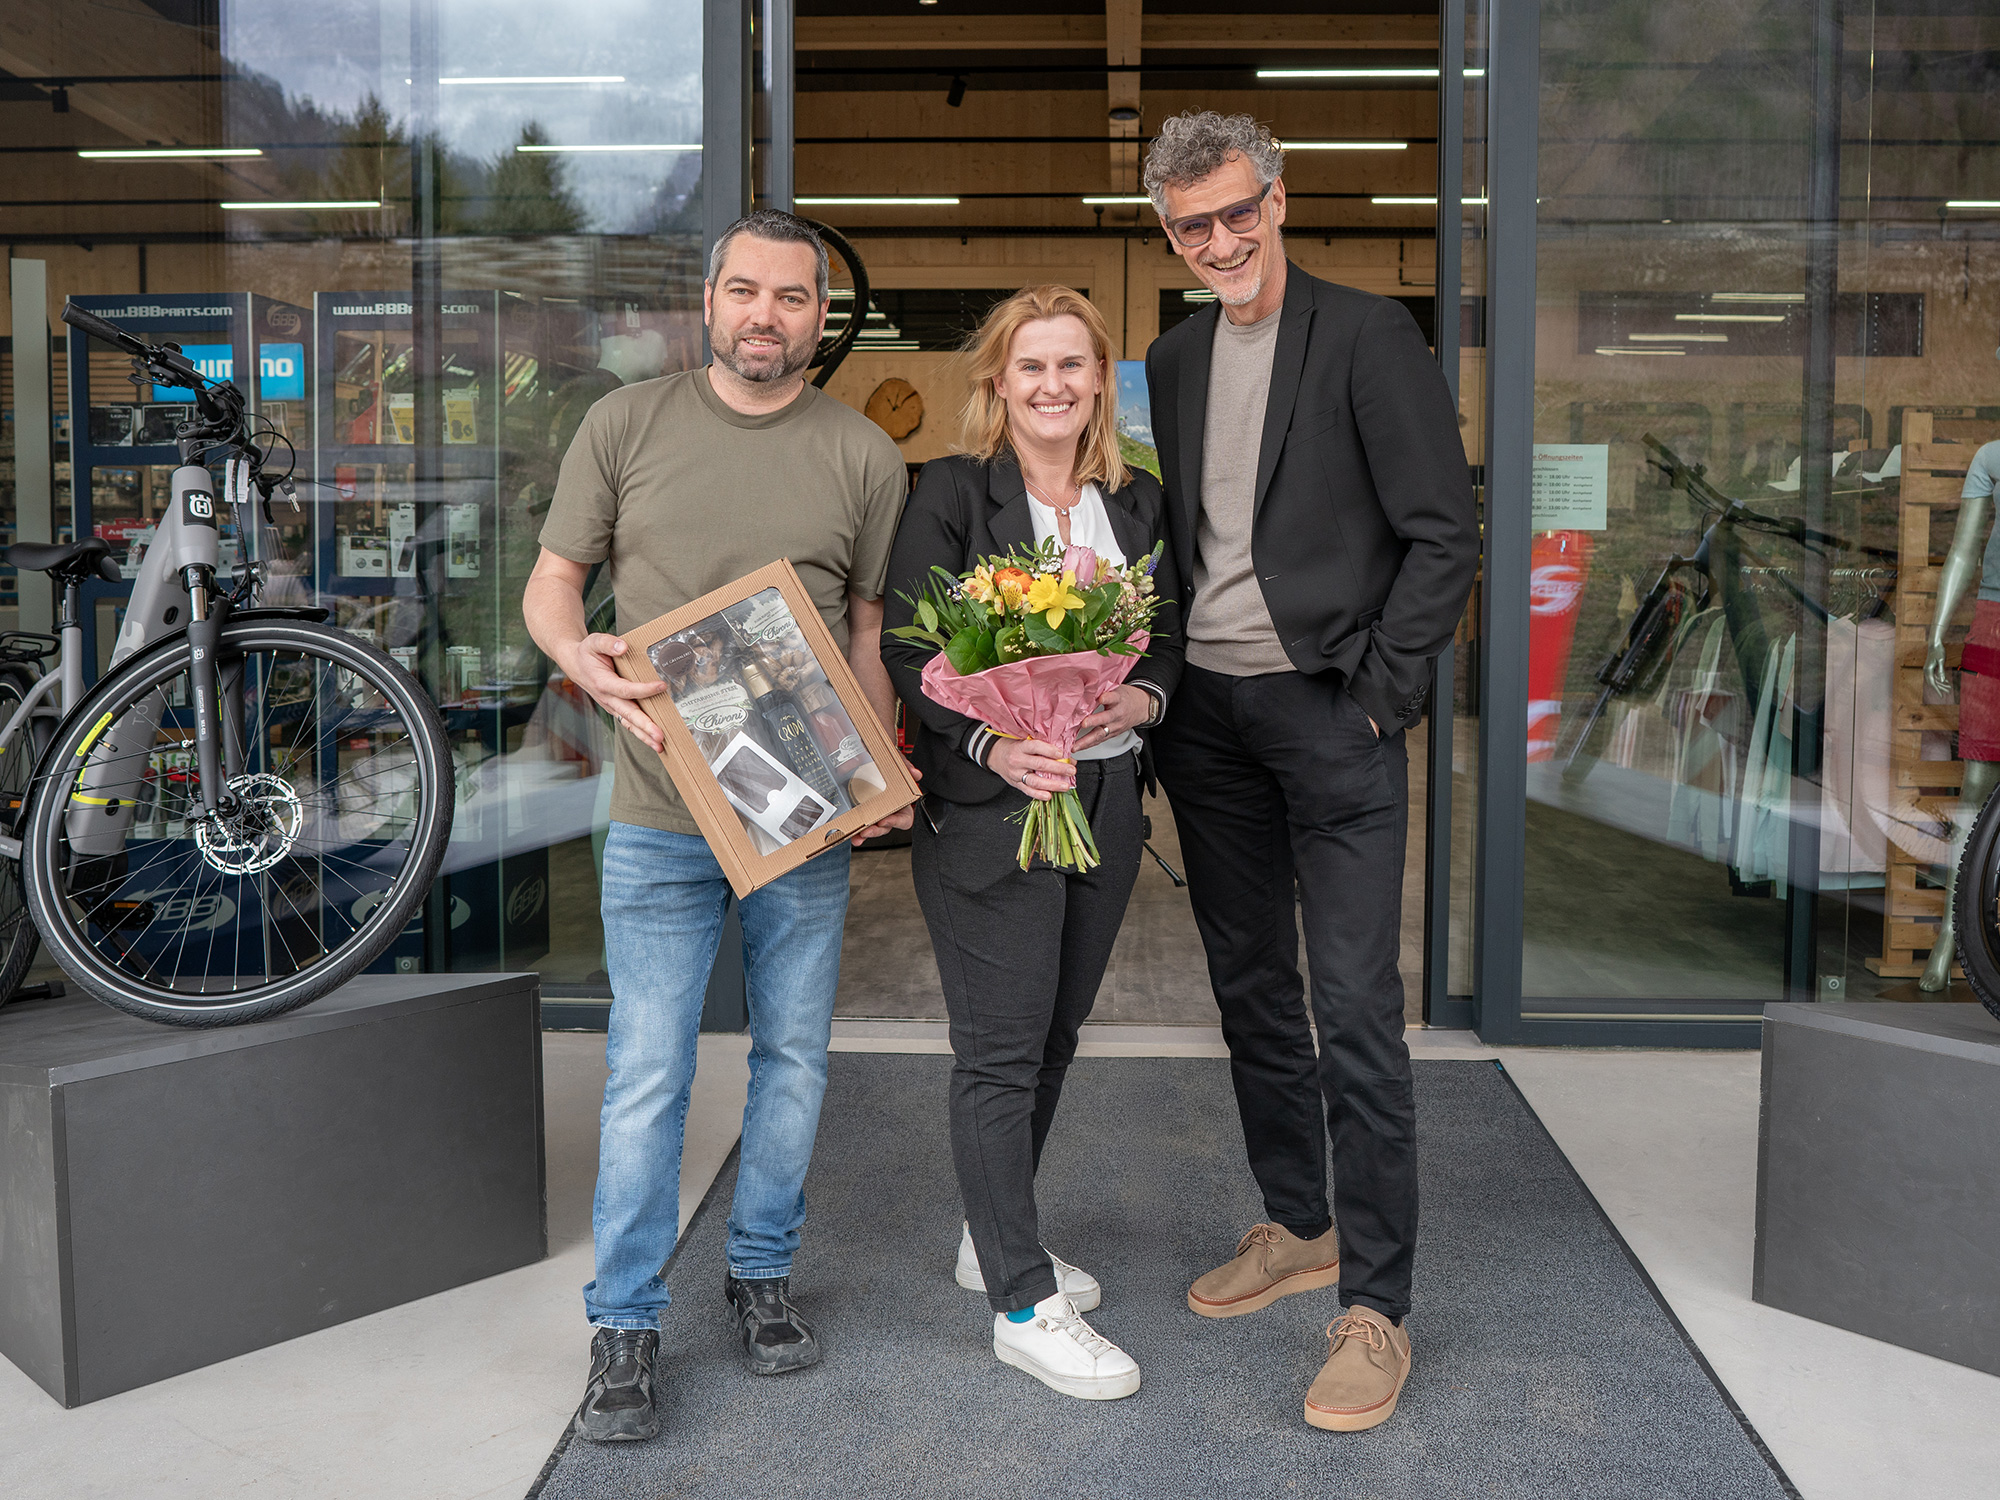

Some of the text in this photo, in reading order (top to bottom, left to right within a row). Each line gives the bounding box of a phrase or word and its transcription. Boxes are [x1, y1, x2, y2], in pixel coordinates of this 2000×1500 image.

[193, 357, 293, 377] HIMNO
[1538, 453, 1583, 461] Öffnungszeiten
[699, 710, 743, 728] Chironi
[778, 719, 805, 742] CRUDO
